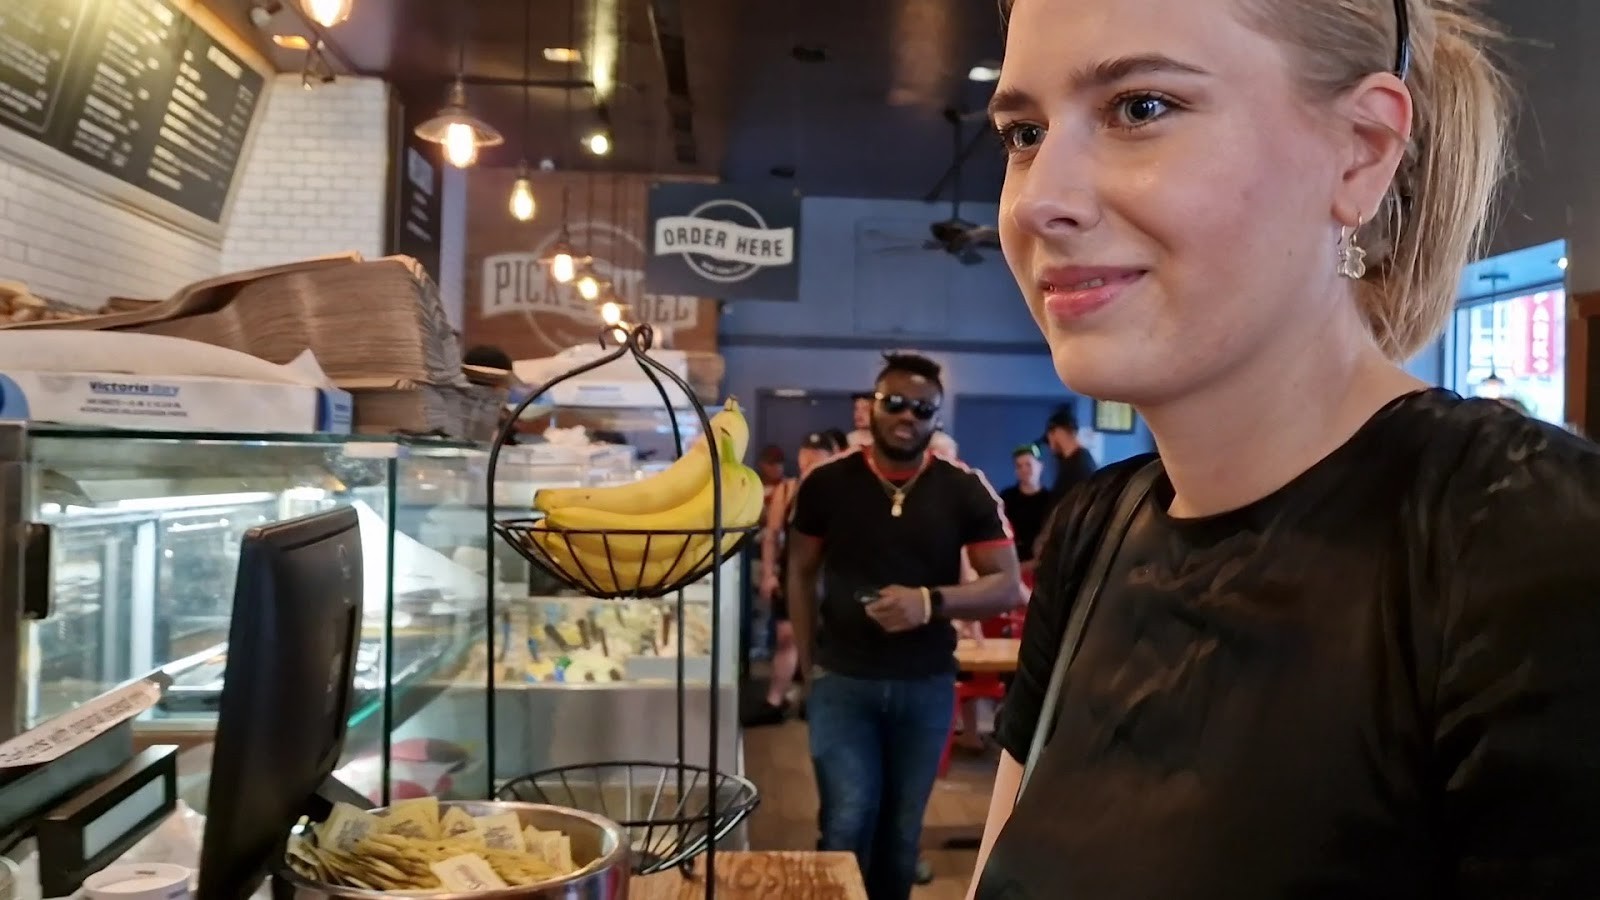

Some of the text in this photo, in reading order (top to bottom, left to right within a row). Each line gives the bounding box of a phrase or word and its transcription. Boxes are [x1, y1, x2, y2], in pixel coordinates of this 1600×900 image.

[662, 225, 784, 257] ORDER HERE
[89, 381, 149, 393] Victoria
